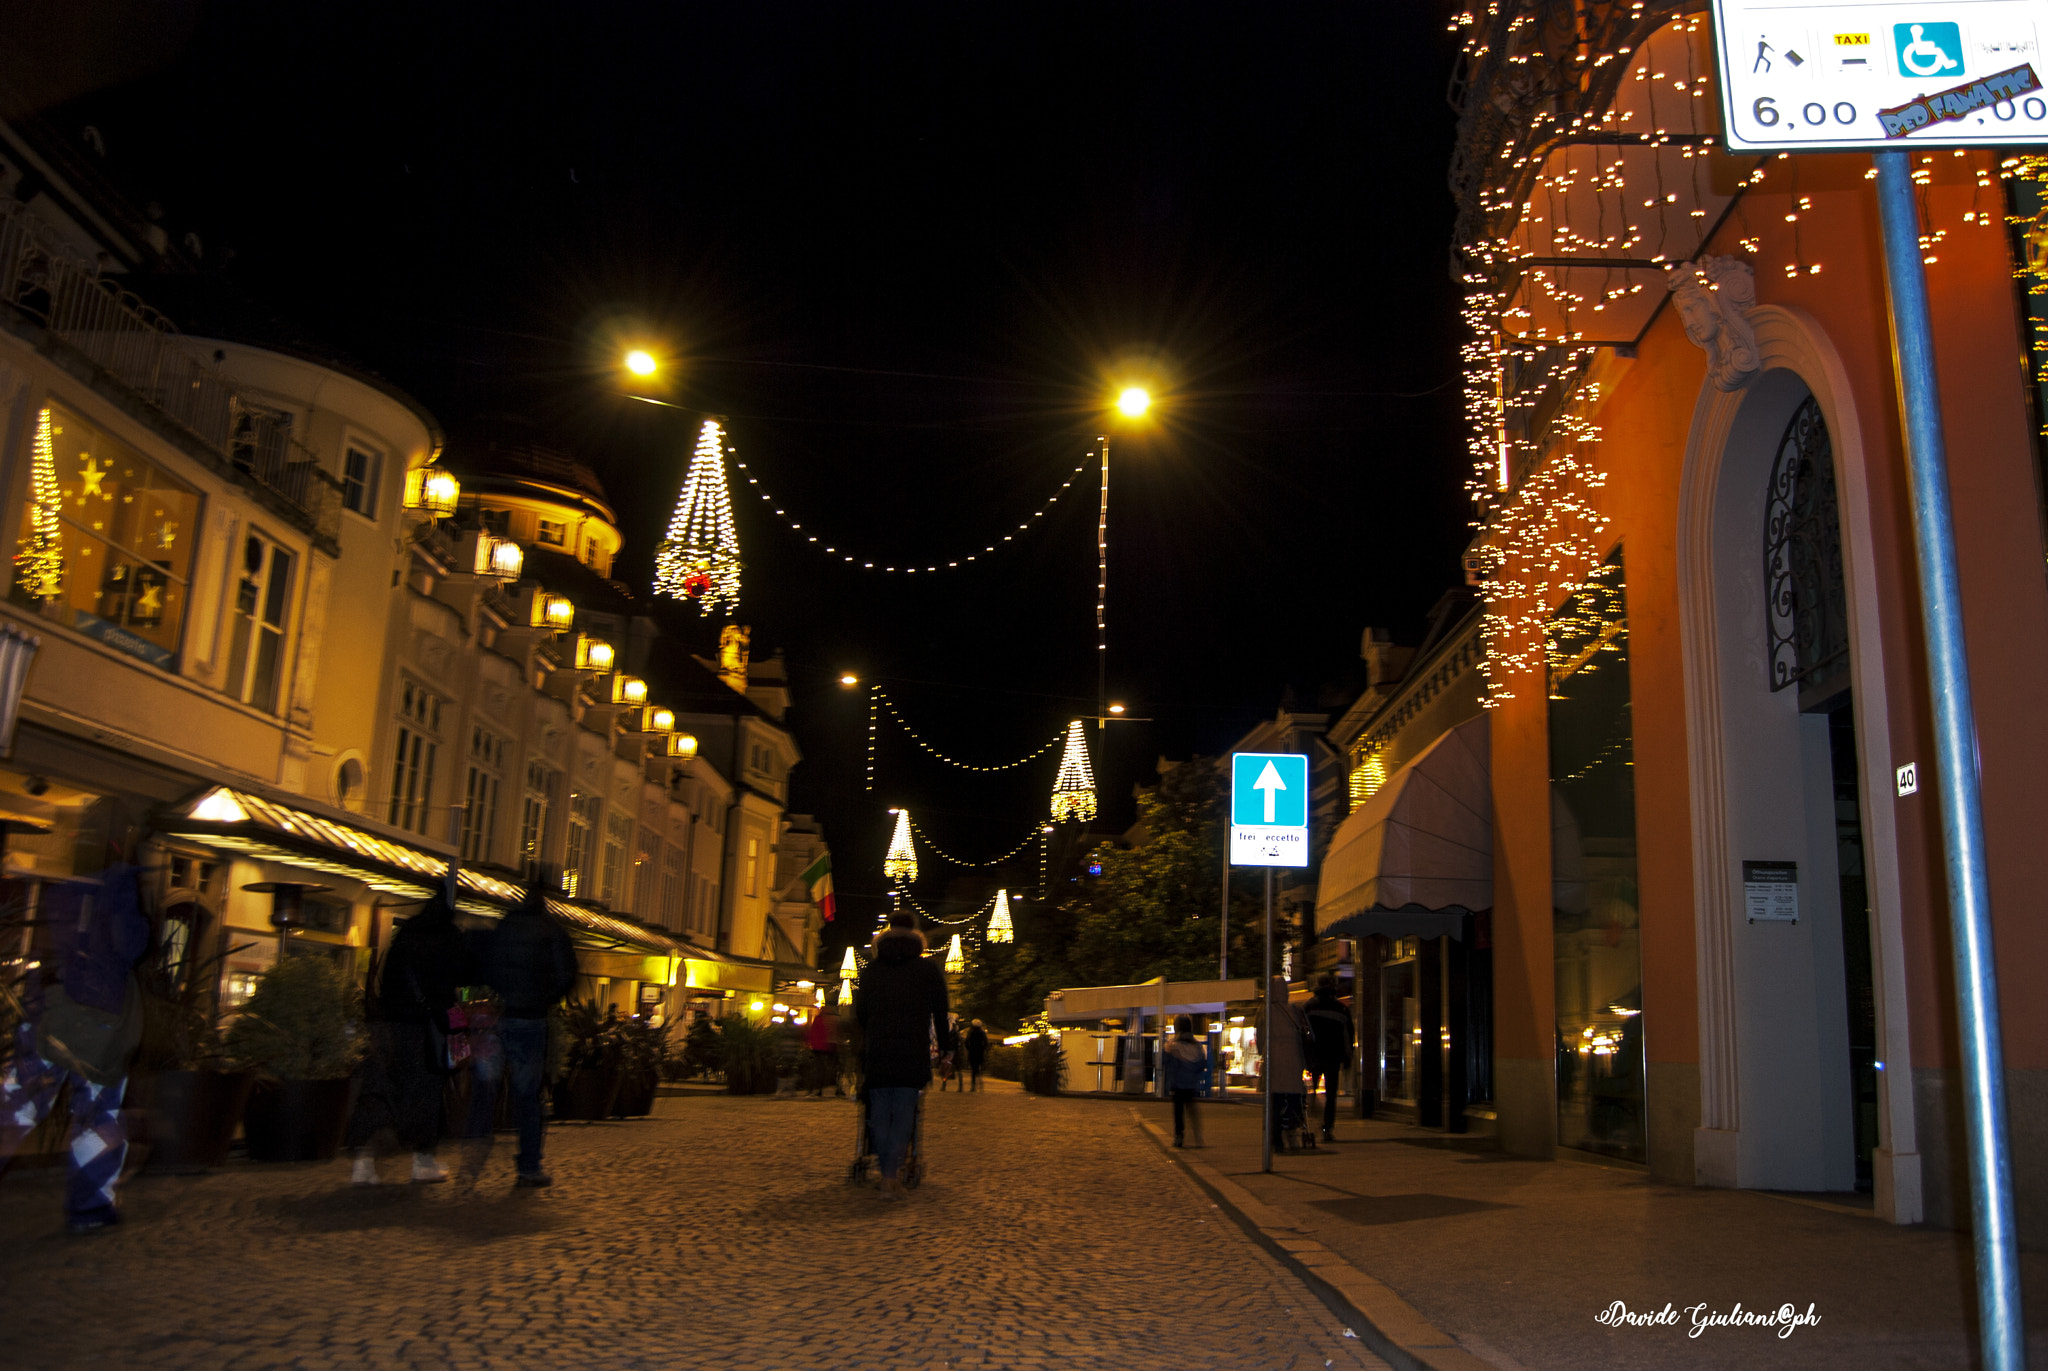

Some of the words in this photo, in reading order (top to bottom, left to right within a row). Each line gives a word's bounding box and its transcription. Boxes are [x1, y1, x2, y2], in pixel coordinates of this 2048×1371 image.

[1835, 35, 1868, 45] TAXI
[1880, 103, 1930, 137] RED
[1928, 67, 2033, 120] FANATIC
[1753, 97, 1857, 130] 6,00
[1900, 769, 1914, 789] 40
[1240, 832, 1256, 841] frei
[1266, 834, 1300, 842] eccetto
